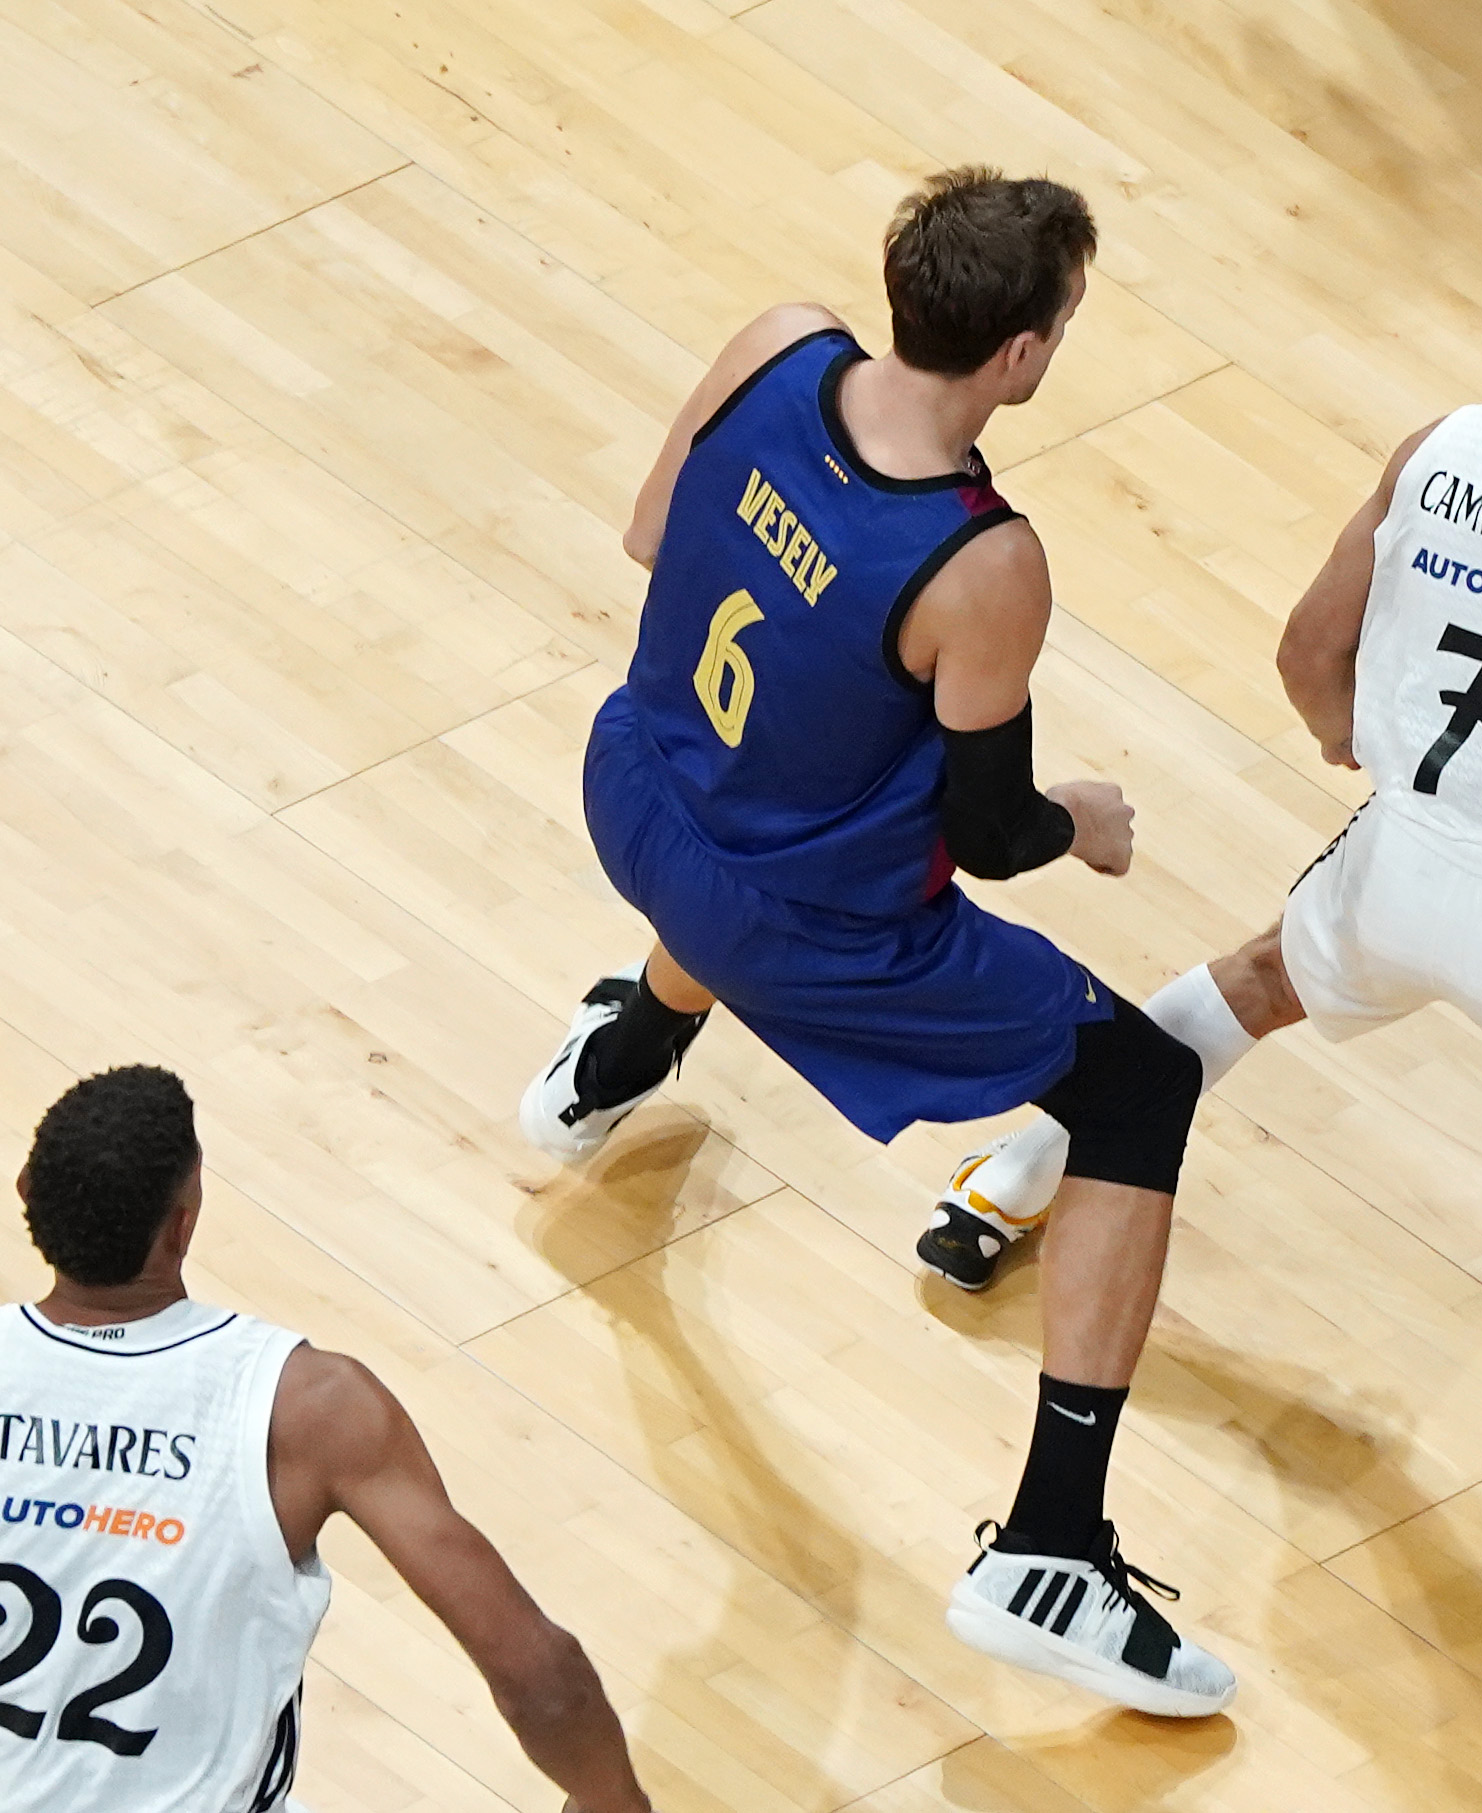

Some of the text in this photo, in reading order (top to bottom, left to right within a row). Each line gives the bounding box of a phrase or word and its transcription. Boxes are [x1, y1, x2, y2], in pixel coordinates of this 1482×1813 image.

[736, 467, 838, 608] VESELY
[693, 588, 765, 748] 6
[91, 1327, 126, 1340] PRO
[0, 1413, 196, 1480] TAVARES
[1, 1496, 185, 1546] UTOHERO
[0, 1562, 173, 1757] 22
